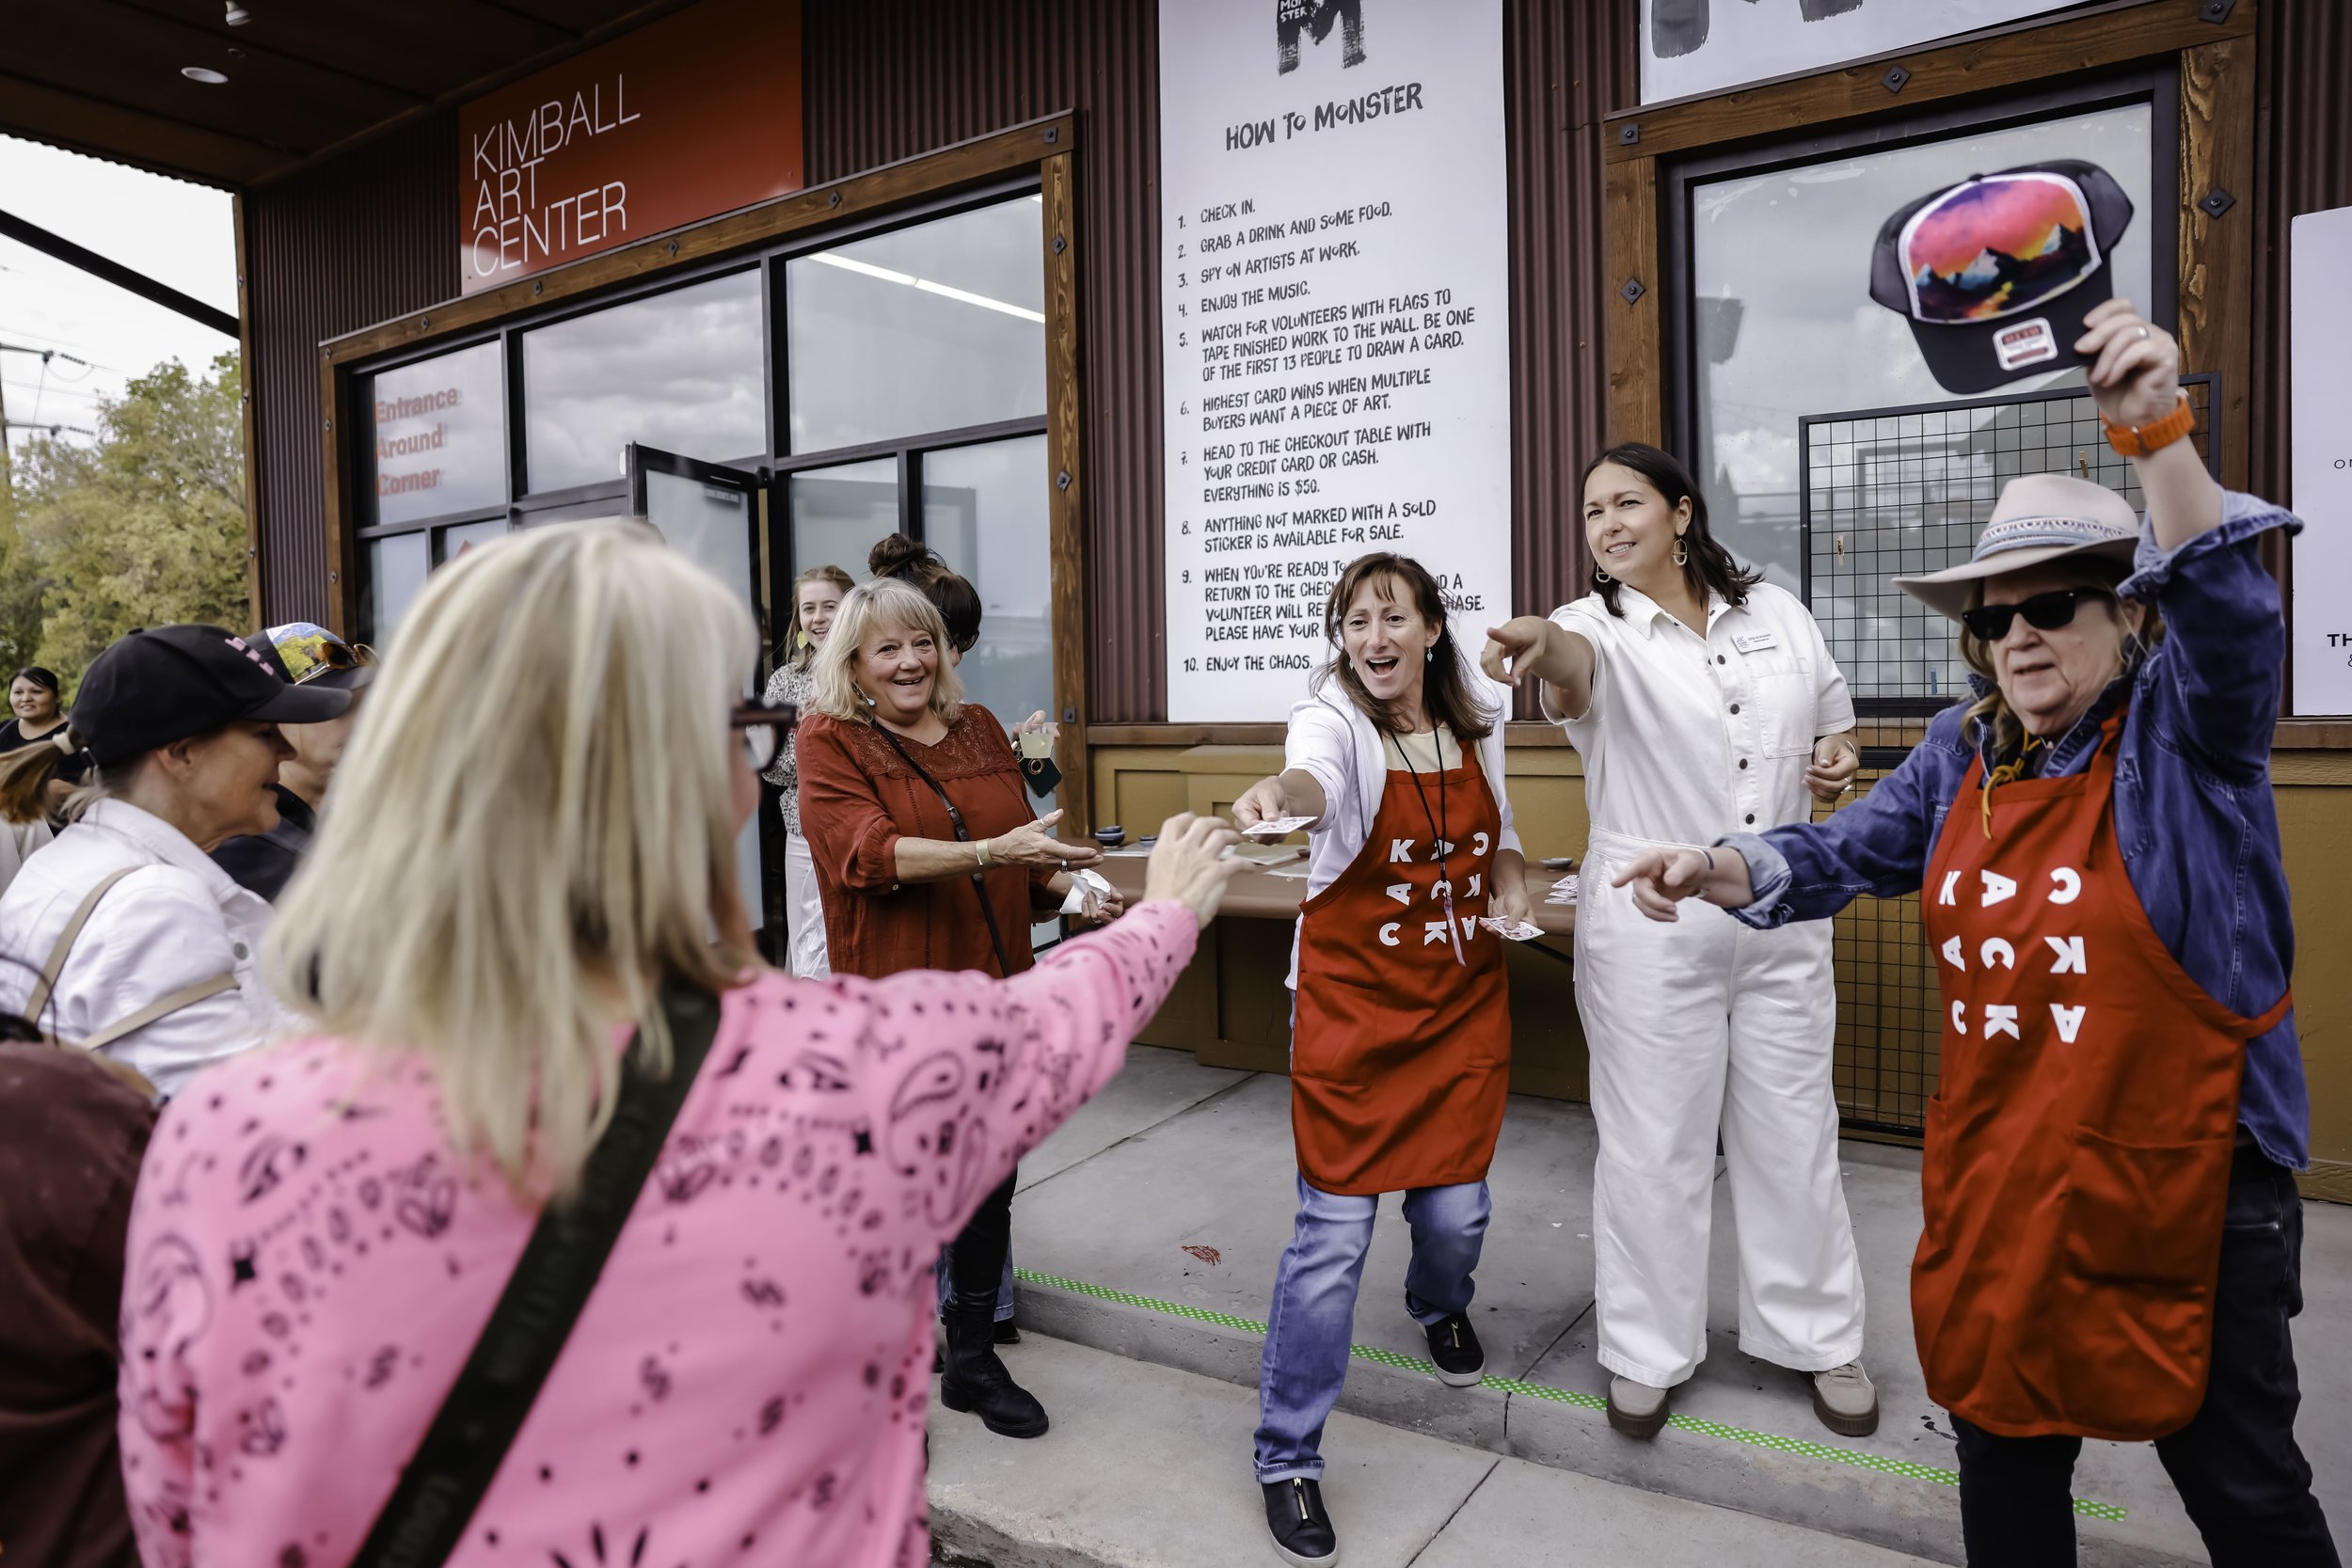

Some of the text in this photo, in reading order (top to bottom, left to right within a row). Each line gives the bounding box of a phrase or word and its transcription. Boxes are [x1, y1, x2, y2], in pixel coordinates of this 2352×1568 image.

[1279, 7, 1308, 23] STER
[474, 73, 641, 181] KIMBALL
[1227, 119, 1275, 150] HOW
[473, 156, 545, 230] ART
[472, 181, 626, 277] CENTER
[1178, 198, 1255, 229] 1. CHECK IN.
[1178, 245, 1185, 259] 2.
[1200, 234, 1232, 252] GRAB
[1236, 231, 1245, 245] A
[1249, 223, 1285, 243] DRINK
[1290, 218, 1315, 234] AND
[1179, 273, 1188, 288] 3.
[1201, 266, 1221, 283] SPY
[1246, 252, 1295, 275] ARTISTS
[1300, 247, 1314, 264] AT
[1179, 280, 1310, 317] 4. ENJOY THE MUSIC.
[1180, 332, 1187, 347] 5.
[1202, 324, 1242, 342] WATCH
[1352, 299, 1384, 319] WITH
[1390, 293, 1429, 313] FLAGS
[1435, 289, 1451, 306] TO
[1202, 345, 1230, 363] TAPE
[1292, 330, 1328, 349] WORK
[1333, 326, 1348, 342] TO
[1354, 323, 1375, 339] THE
[1381, 317, 1419, 335] WALL.
[1424, 312, 1440, 329] BE
[1446, 307, 1475, 325] ONE
[1203, 366, 1216, 382] OF
[1220, 363, 1242, 380] THE
[1283, 355, 1296, 371] 13
[1301, 348, 1342, 368] PEOPLE
[1347, 344, 1361, 361] TO
[1367, 340, 1405, 357] DRAW
[1409, 336, 1420, 353] A
[1424, 331, 1464, 350] CARD.
[374, 388, 458, 423] Entrance
[1181, 402, 1189, 415] 6.
[1203, 392, 1249, 412] HIGHEST
[1254, 387, 1286, 404] CARD
[1328, 377, 1366, 396] WHEN
[1372, 368, 1431, 389] MULTIPLE
[1250, 406, 1286, 426] WANT
[1291, 405, 1299, 420] A
[1305, 402, 1338, 419] PIECE
[1343, 398, 1358, 414] OF
[1363, 393, 1391, 411] ART.
[375, 422, 443, 459] Around
[1204, 444, 1234, 461] HEAD
[1239, 441, 1253, 457] TO
[1258, 438, 1280, 454] THE
[1285, 430, 1349, 451] CHECKOUT
[1354, 426, 1392, 445] TABLE
[1397, 421, 1430, 441] WITH
[1237, 459, 1277, 477] CREDIT
[1281, 455, 1314, 472] CARD
[1320, 452, 1337, 468] OR
[1343, 449, 1378, 466] CASH.
[2334, 459, 2352, 469] O
[376, 467, 440, 497] Corner
[1204, 483, 1274, 502] EVERYTHING
[1295, 479, 1319, 496] $50.
[1182, 521, 1191, 534] 8.
[1293, 507, 1346, 526] MARKED
[1352, 504, 1383, 521] WITH
[1388, 502, 1397, 518] A
[1370, 524, 1404, 540] SALE.
[1183, 570, 1191, 583] 9.
[1205, 567, 1239, 582] WHEN
[1244, 563, 1282, 579] YOU'RE
[1288, 561, 1328, 578] READY
[1205, 586, 1250, 602] RETURN
[1255, 584, 1269, 599] TO
[1274, 583, 1295, 598] THE
[1300, 579, 1334, 596] CHEC
[1454, 573, 1463, 589] A
[1206, 626, 1248, 641] PLEASE
[1253, 625, 1284, 640] HAVE
[1184, 657, 1199, 673] 10.
[1244, 656, 1264, 671] THE
[1269, 655, 1312, 669] CHAOS.
